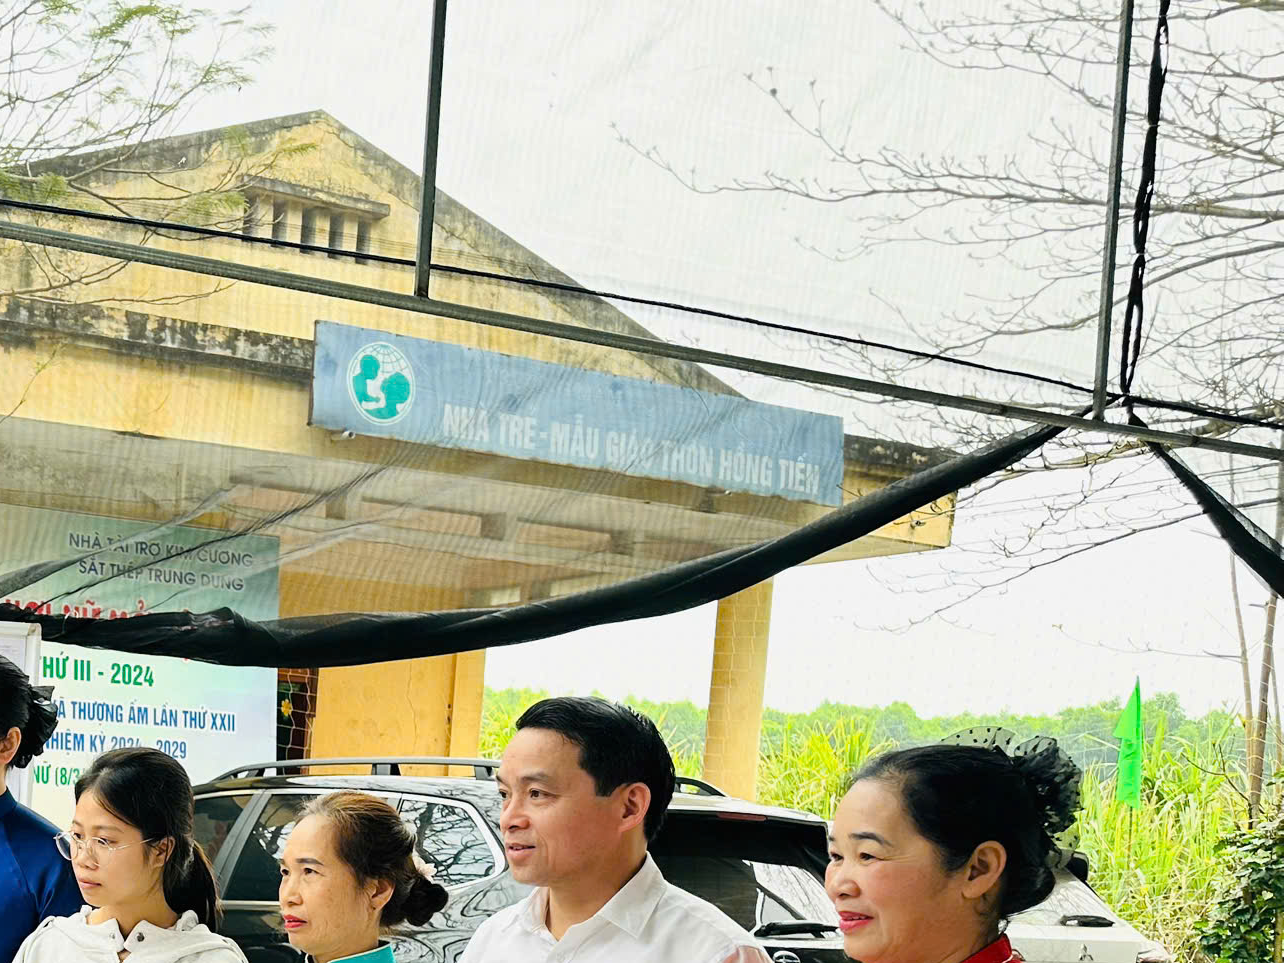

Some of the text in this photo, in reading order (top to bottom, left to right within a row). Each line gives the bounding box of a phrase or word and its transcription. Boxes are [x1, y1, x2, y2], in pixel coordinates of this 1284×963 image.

[778, 452, 820, 495] TIẾN
[69, 531, 102, 550] NHÀ
[134, 541, 161, 559] TRỢ
[196, 548, 254, 568] CƯƠNG
[148, 568, 196, 586] TRUNG
[40, 651, 69, 679] HỨ
[73, 659, 92, 681] III
[111, 662, 154, 687] 2024
[53, 696, 66, 718] Ã
[71, 700, 124, 726] THƯỢNG
[153, 701, 177, 727] LẦN
[182, 705, 207, 729] THỨ
[210, 712, 235, 732] XXII
[90, 730, 106, 752] KỲ
[156, 739, 186, 759] 2029
